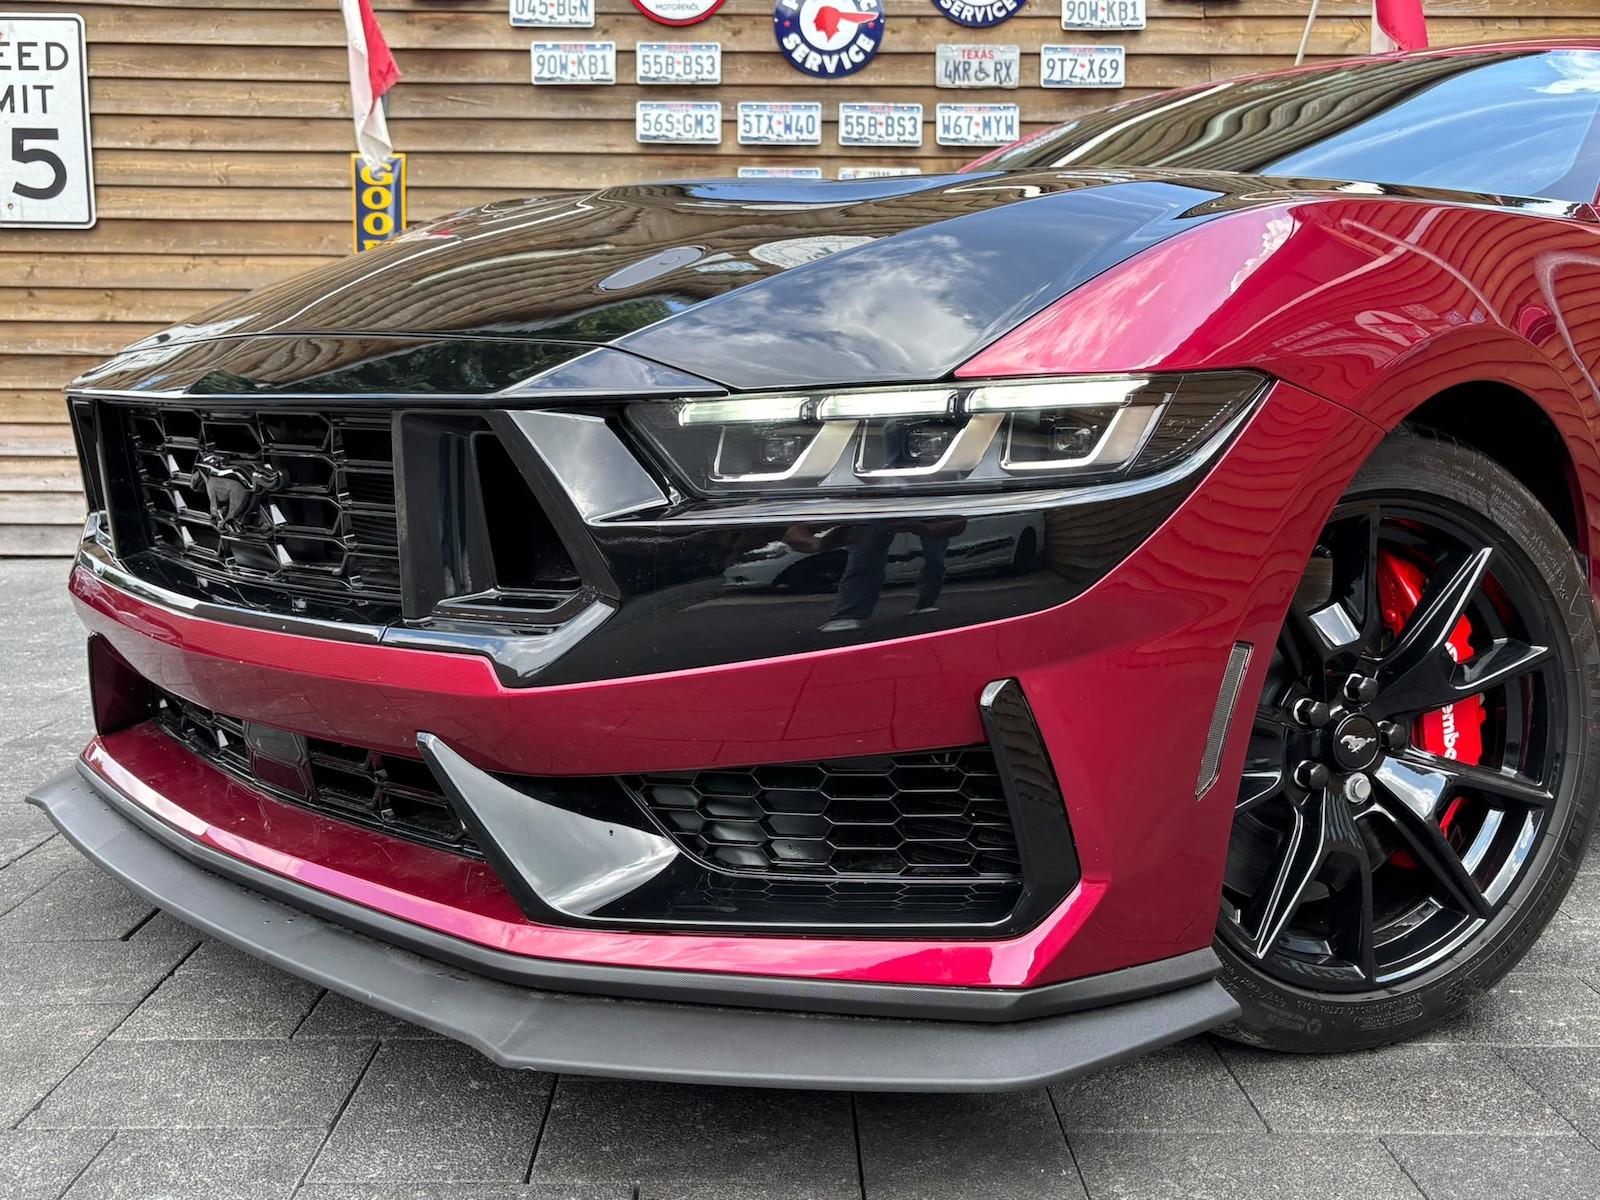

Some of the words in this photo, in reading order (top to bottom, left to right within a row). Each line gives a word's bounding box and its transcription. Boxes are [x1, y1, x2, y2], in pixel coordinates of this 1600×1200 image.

[557, 0, 590, 17] BGN
[940, 0, 1018, 22] SERVICE
[1067, 1, 1098, 21] 90W
[1107, 1, 1139, 21] KB1
[782, 33, 875, 73] SERVICE
[961, 48, 994, 60] TEXAS
[537, 54, 569, 75] 90W
[577, 54, 610, 75] KB1
[642, 55, 675, 75] 55B
[683, 55, 716, 75] BS3
[944, 60, 971, 82] 4KR
[994, 61, 1013, 83] RX
[1046, 58, 1078, 79] 9TZ
[1087, 58, 1119, 79] X69
[642, 113, 674, 133] 56S
[683, 114, 716, 134] GM3
[743, 114, 774, 134] 5TX
[784, 114, 815, 135] W40
[844, 115, 877, 136] 55B
[885, 116, 918, 137] BS3
[942, 115, 973, 136] W67
[982, 115, 1014, 136] MYW
[12, 127, 67, 200] 5
[360, 162, 394, 251] GOO
